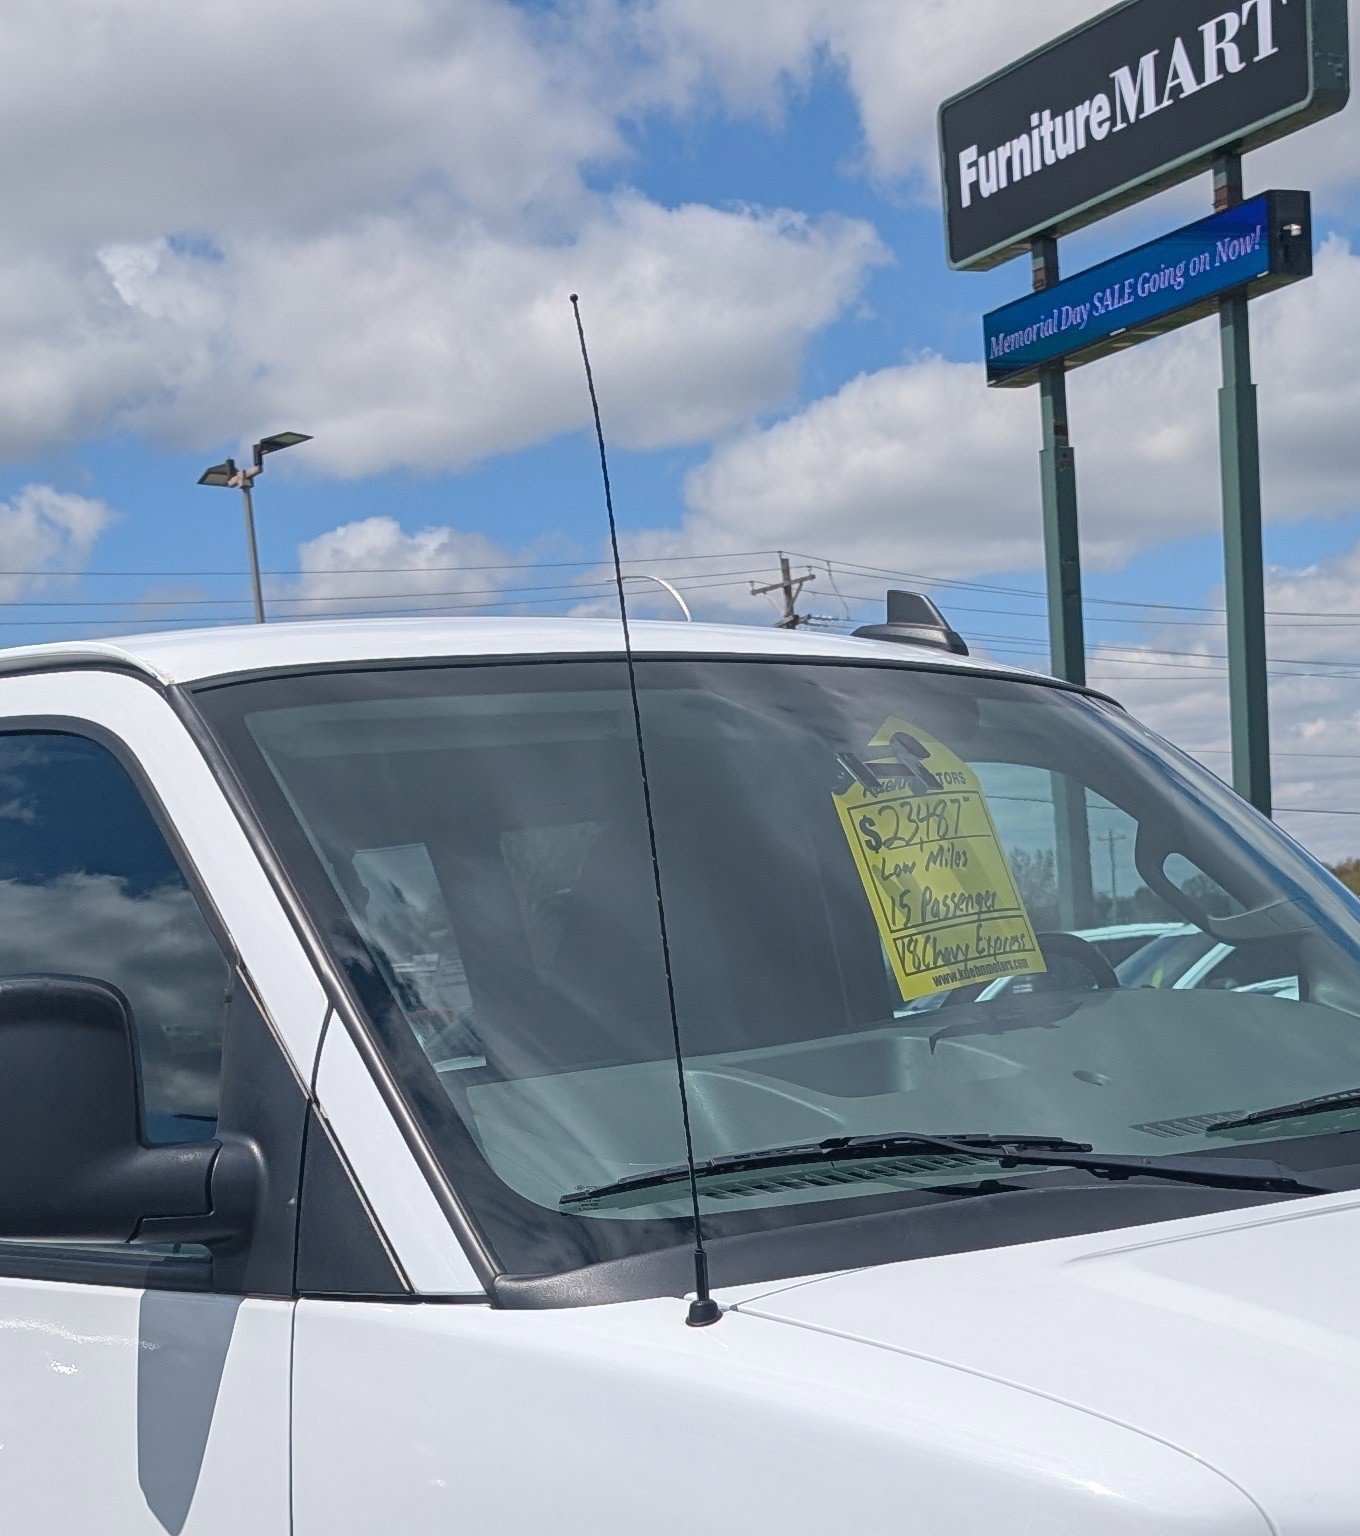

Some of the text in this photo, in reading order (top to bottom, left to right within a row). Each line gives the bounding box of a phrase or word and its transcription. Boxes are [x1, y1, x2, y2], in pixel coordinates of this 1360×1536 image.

[989, 224, 1262, 360] Memorial Day SALE Going on Now!
[881, 842, 968, 881] Low Miles
